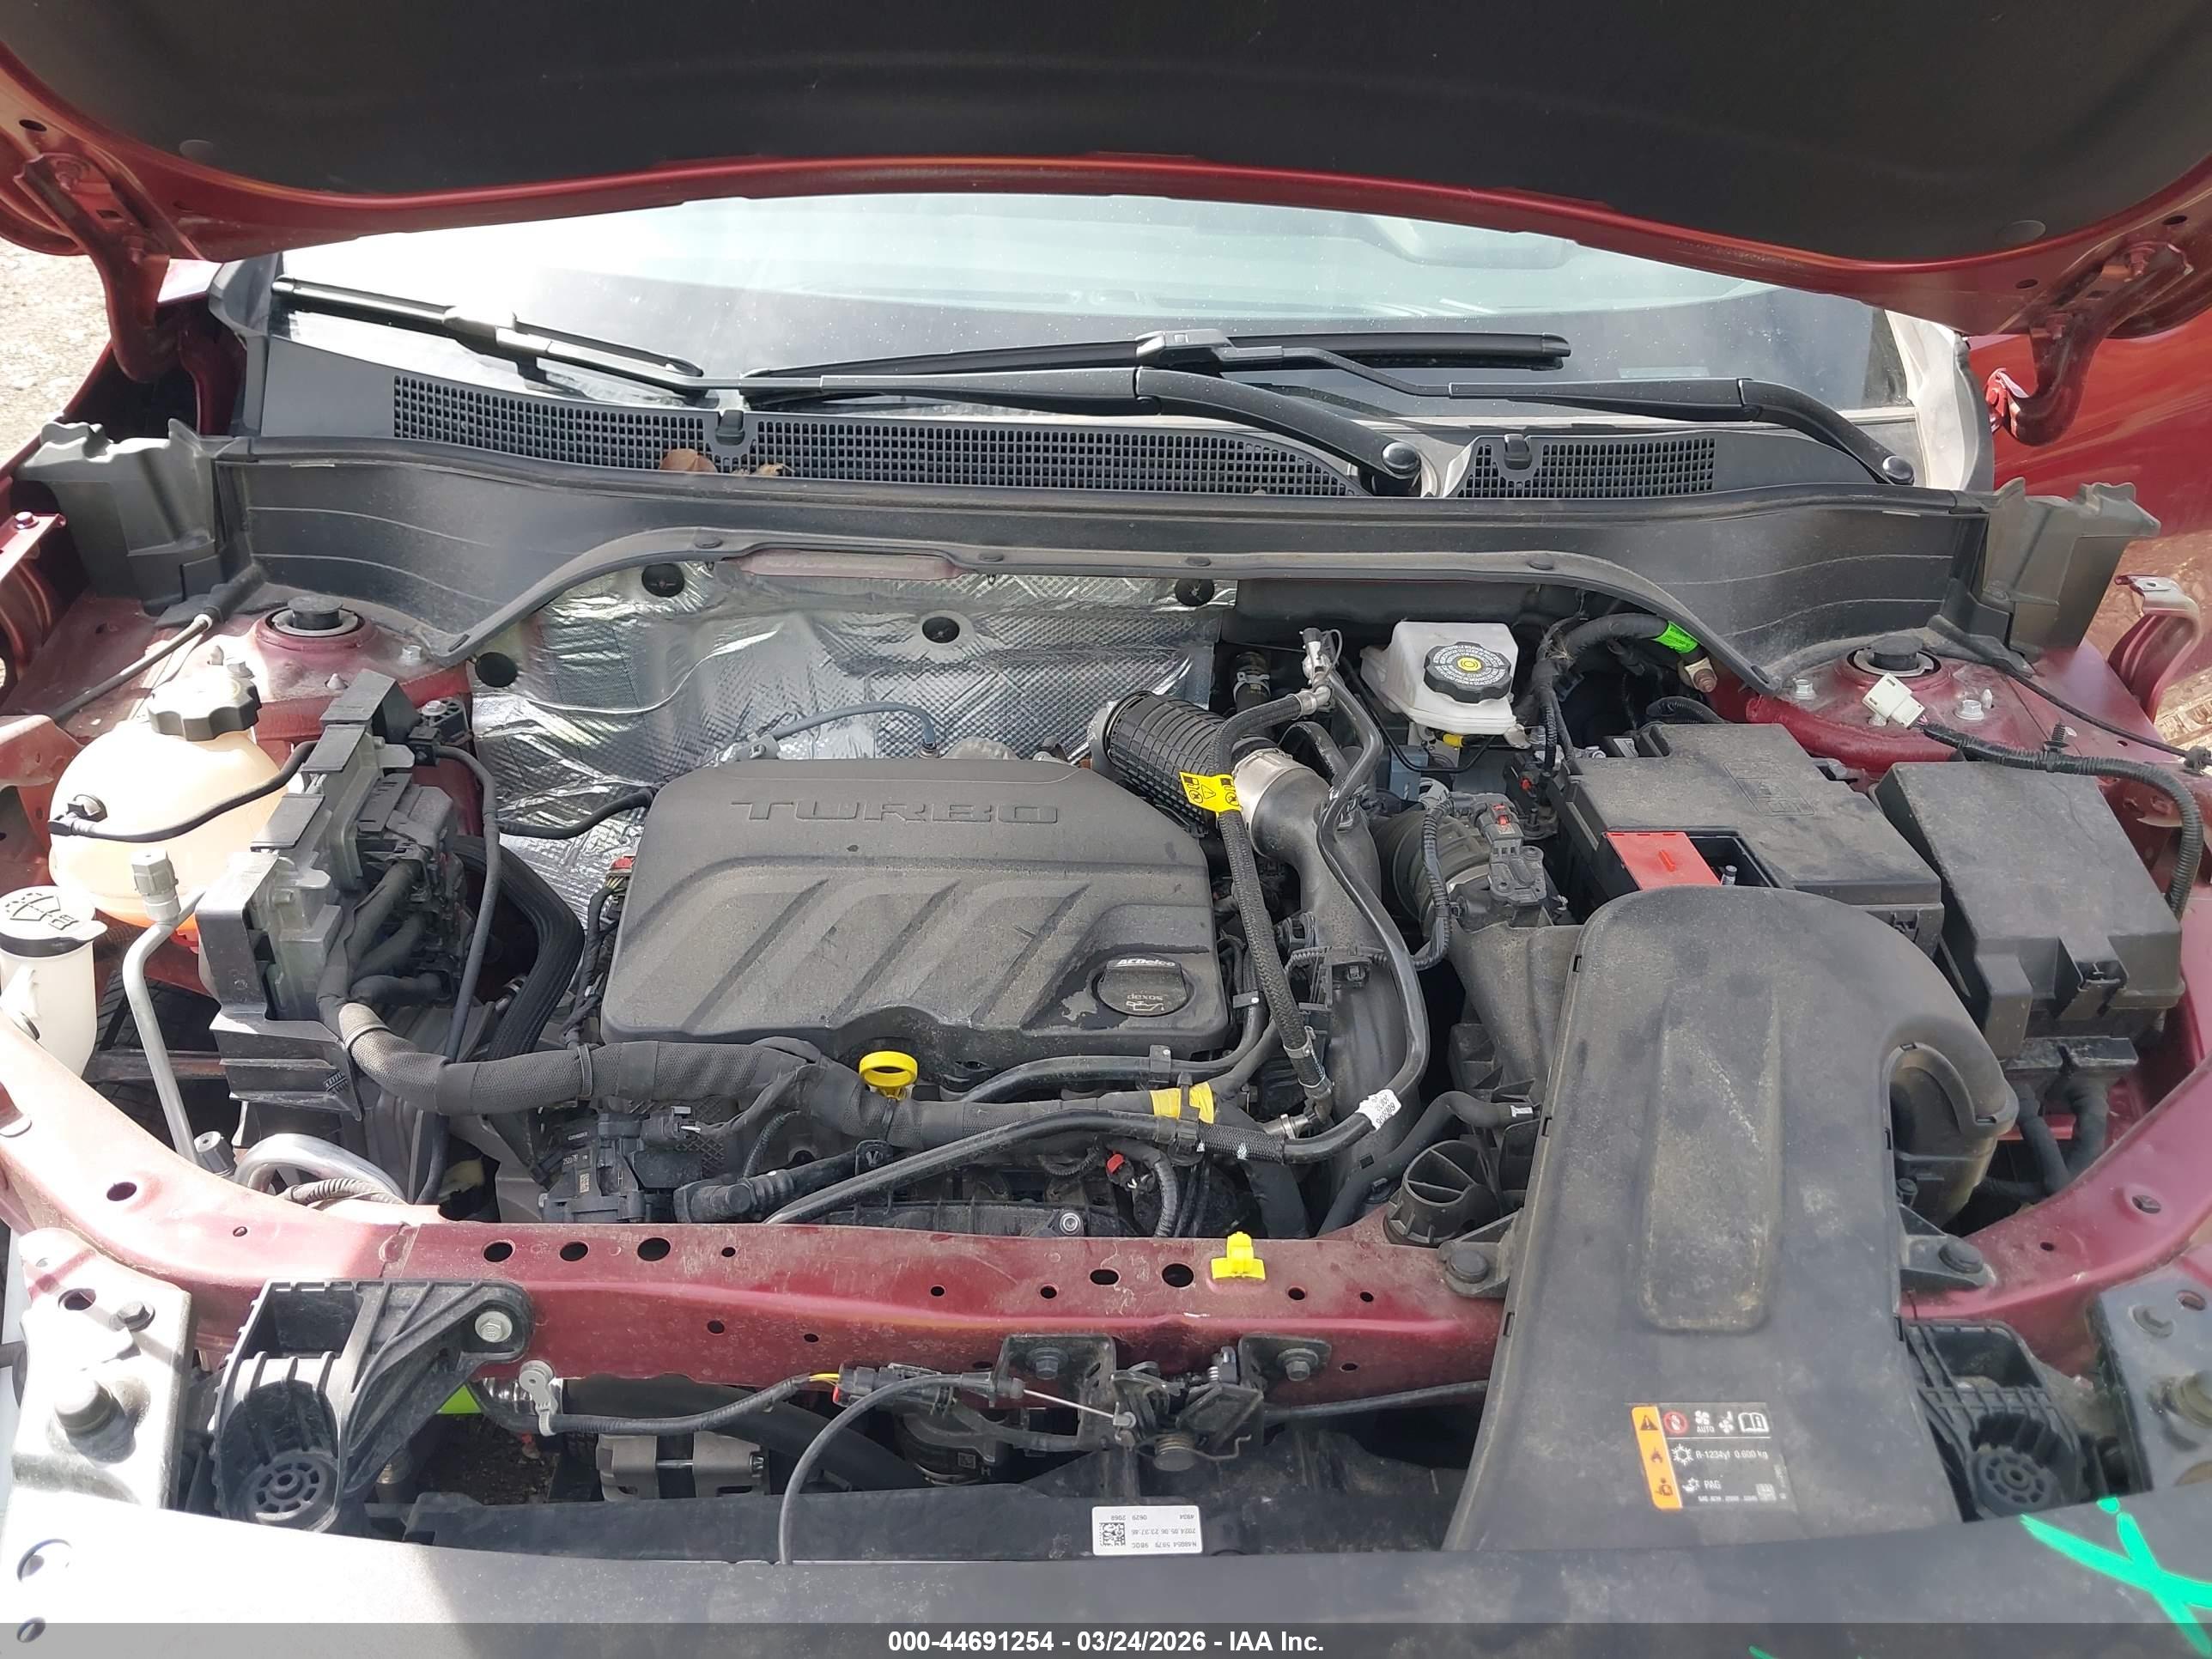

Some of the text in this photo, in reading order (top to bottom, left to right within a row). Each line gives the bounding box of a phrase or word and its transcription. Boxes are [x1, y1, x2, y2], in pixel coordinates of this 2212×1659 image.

[731, 800, 1058, 824] TURBO
[1116, 958, 1176, 967] ACDelco
[1127, 993, 1164, 1001] dexos
[1704, 1480, 1722, 1490] PAG
